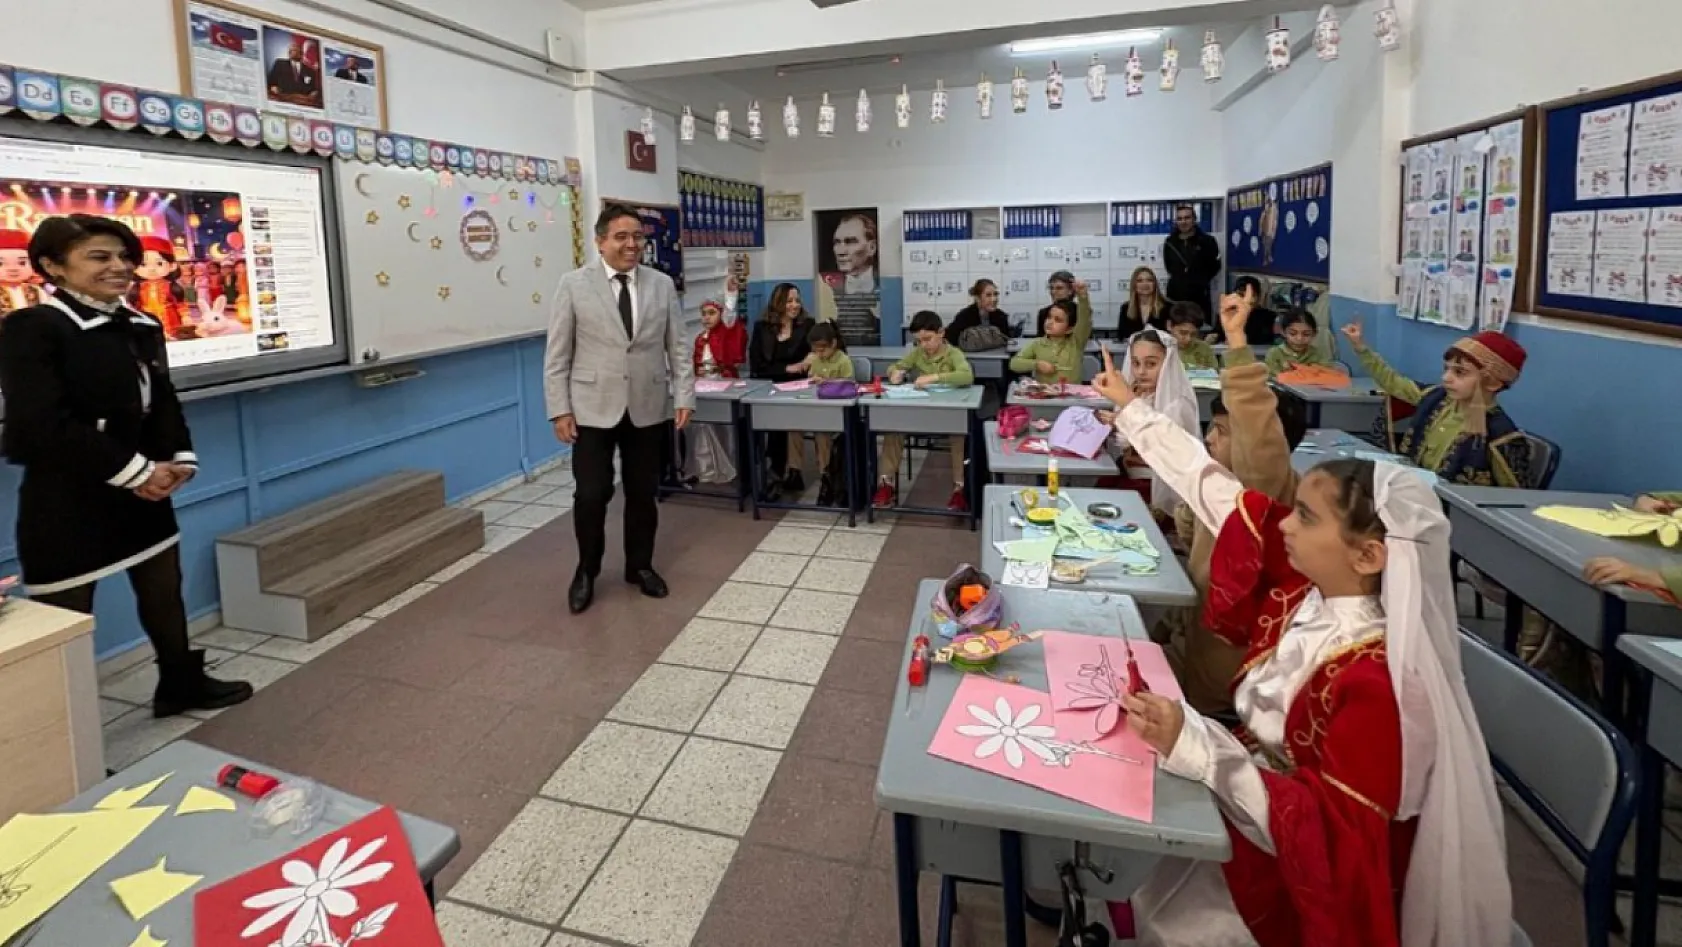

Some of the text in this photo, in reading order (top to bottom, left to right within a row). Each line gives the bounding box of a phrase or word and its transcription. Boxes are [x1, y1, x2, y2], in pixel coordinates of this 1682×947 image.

[24, 83, 53, 101] Dd
[70, 90, 93, 107] Ee
[110, 96, 129, 113] Ff
[145, 101, 167, 118] Gg
